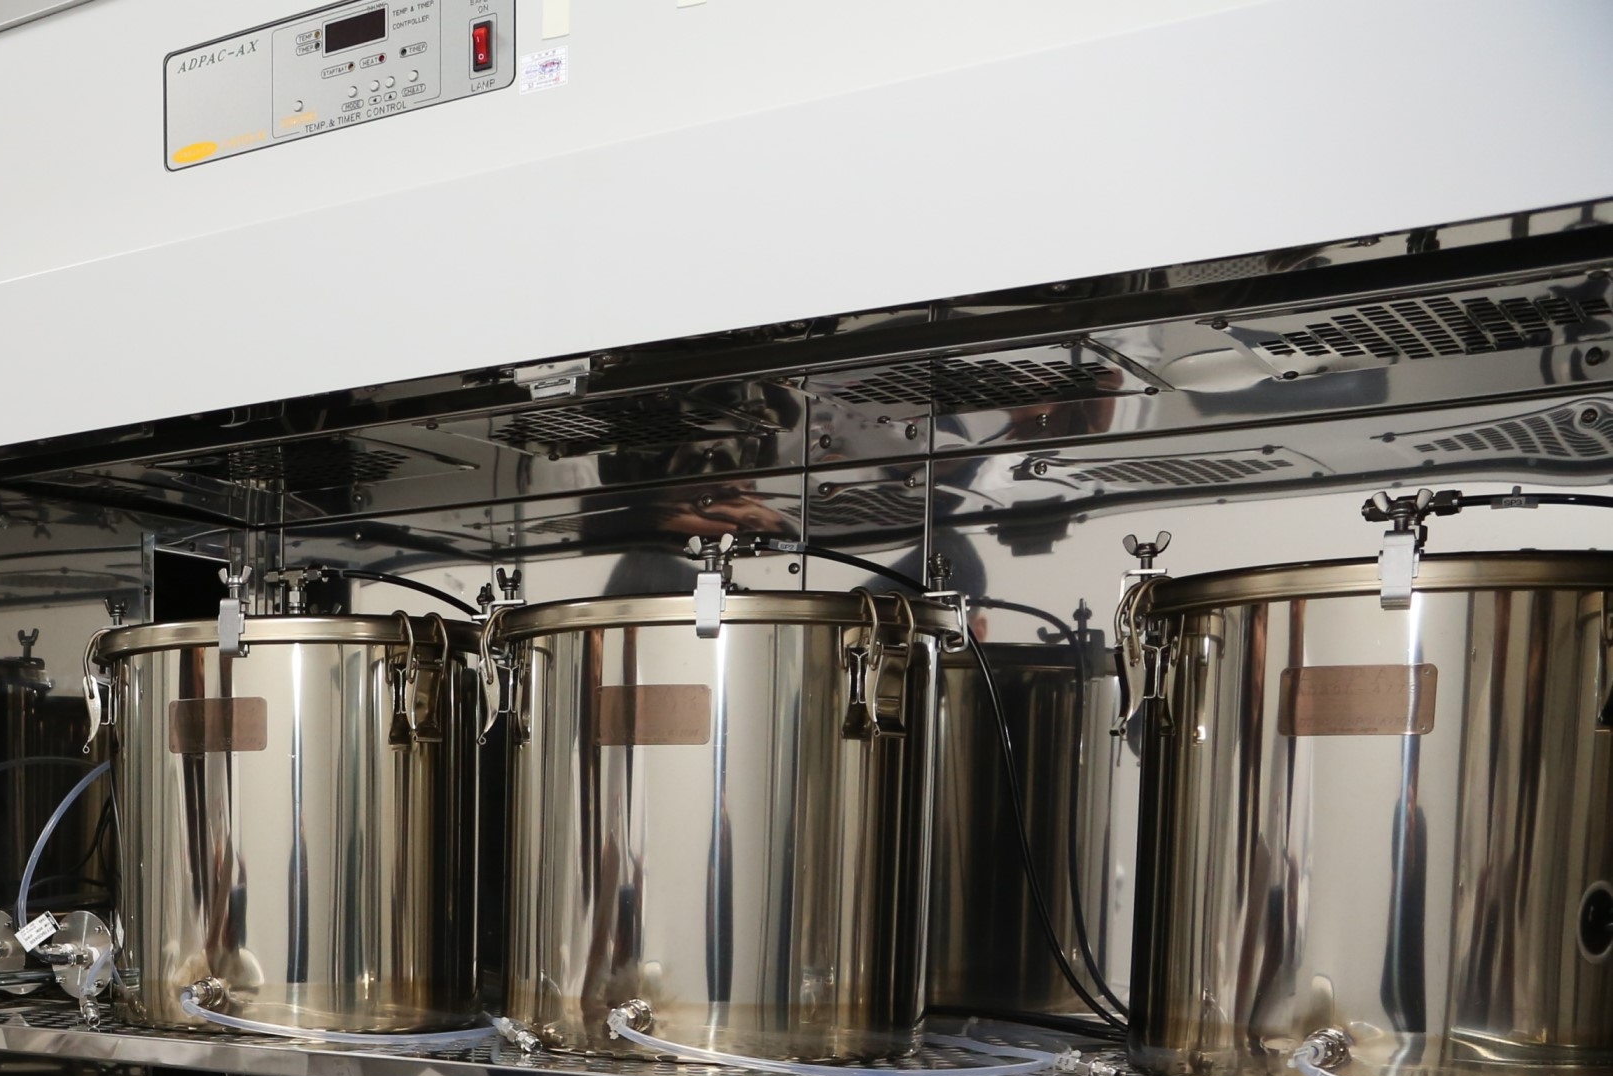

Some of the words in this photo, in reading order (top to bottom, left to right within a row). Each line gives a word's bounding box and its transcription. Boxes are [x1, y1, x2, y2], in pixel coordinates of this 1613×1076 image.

[477, 4, 489, 14] ON
[392, 14, 430, 30] CONTROLLER
[409, 43, 426, 53] TIMER
[177, 39, 260, 74] ADPAC-AX
[362, 57, 378, 66] HEAT
[470, 78, 496, 92] LAMP
[344, 100, 361, 111] MODE
[337, 111, 362, 125] TIMER
[366, 100, 407, 118] CONTROL
